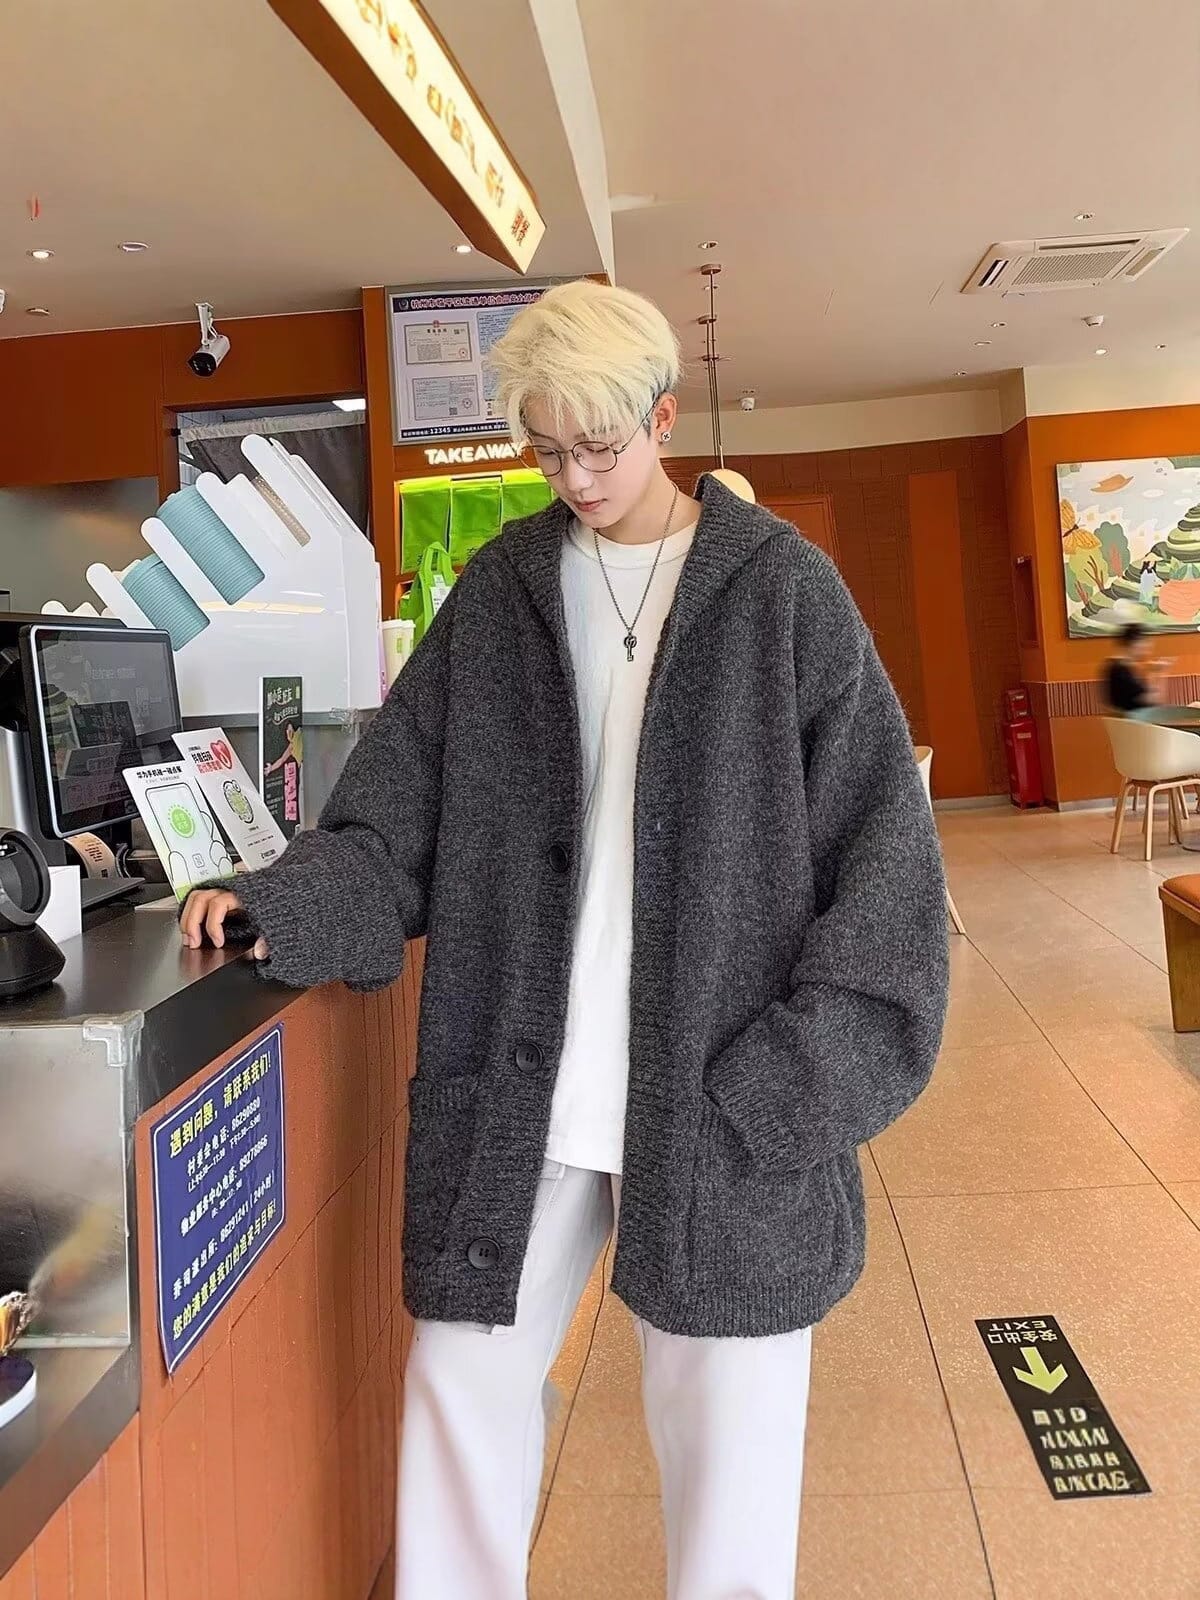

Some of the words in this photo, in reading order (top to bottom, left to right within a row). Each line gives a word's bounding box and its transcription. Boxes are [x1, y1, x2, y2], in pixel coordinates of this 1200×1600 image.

[989, 1320, 1047, 1331] EXIT
[987, 1329, 1058, 1344] 安全出口
